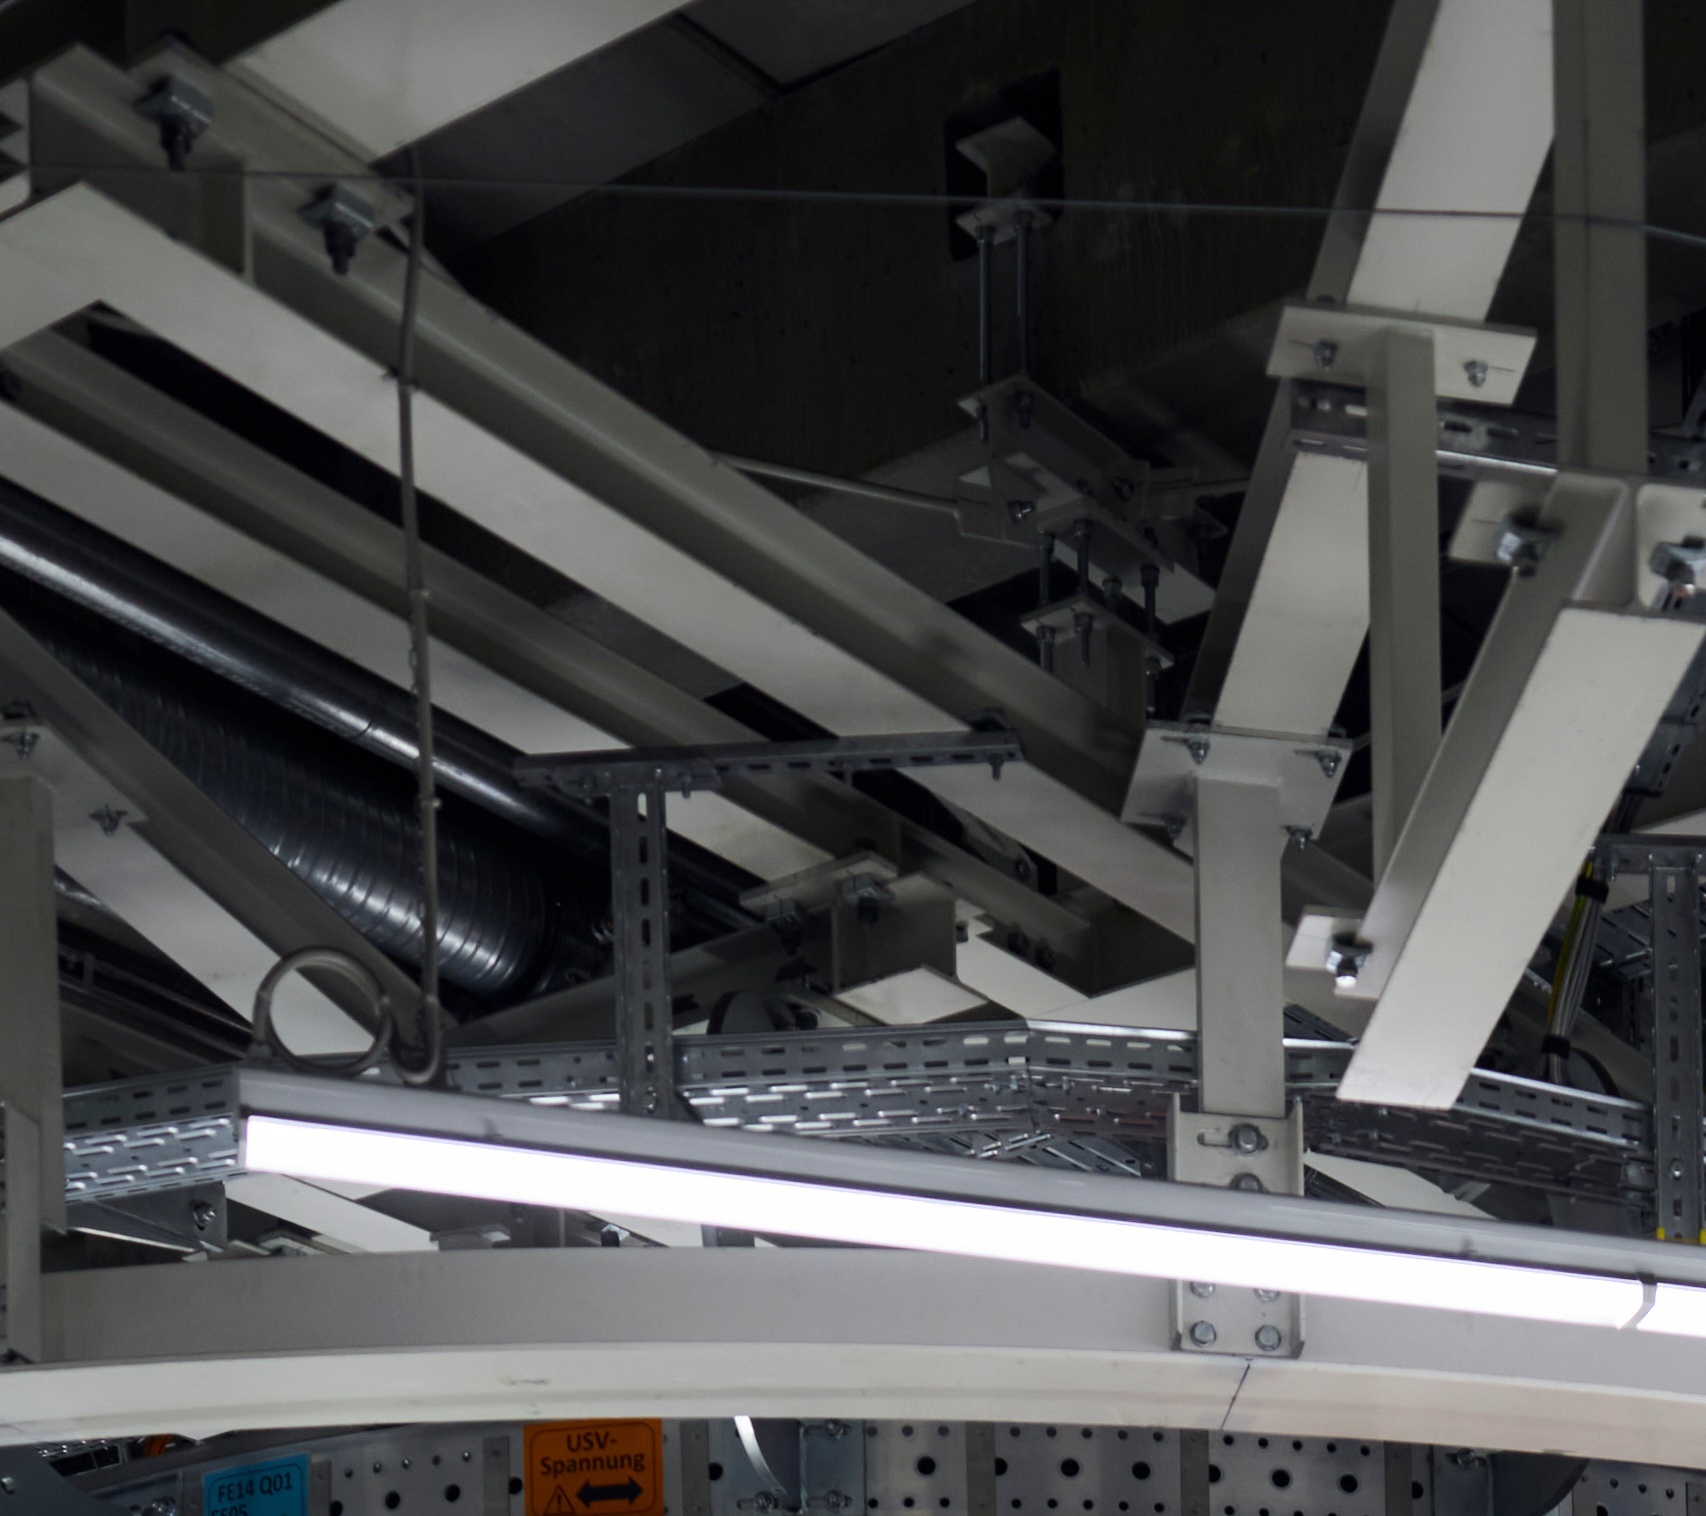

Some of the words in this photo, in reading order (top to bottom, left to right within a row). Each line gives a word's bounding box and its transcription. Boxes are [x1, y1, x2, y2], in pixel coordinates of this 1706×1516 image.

[566, 1431, 617, 1453] USV-
[540, 1453, 646, 1479] Spannung
[217, 1479, 255, 1503] FE14
[259, 1471, 293, 1496] Q01
